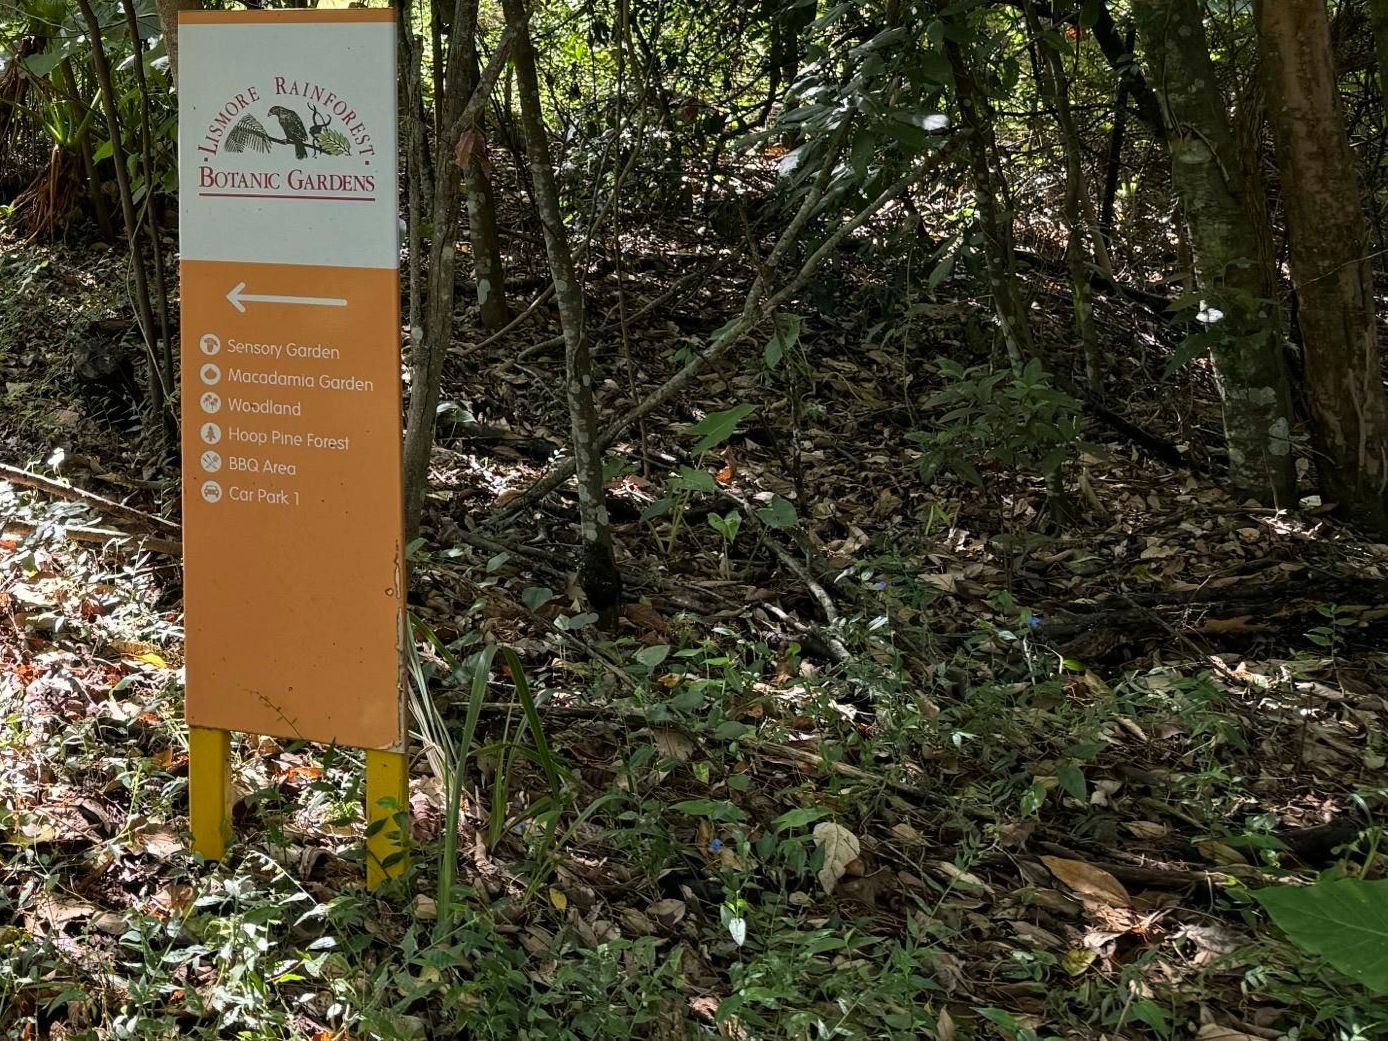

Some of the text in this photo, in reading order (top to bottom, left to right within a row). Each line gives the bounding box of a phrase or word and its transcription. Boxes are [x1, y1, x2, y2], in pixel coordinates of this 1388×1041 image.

[198, 77, 375, 156] LISMORE RAINFOREST
[199, 167, 375, 192] BOTANIC GARDENS
[227, 340, 340, 359] Sensory Garden
[228, 369, 373, 391] Macadamia Garden
[228, 398, 300, 416] Woodland
[229, 428, 349, 449] Hoop Pine Forest
[229, 457, 296, 475] BBQ Area
[229, 487, 299, 505] Car Park 1
